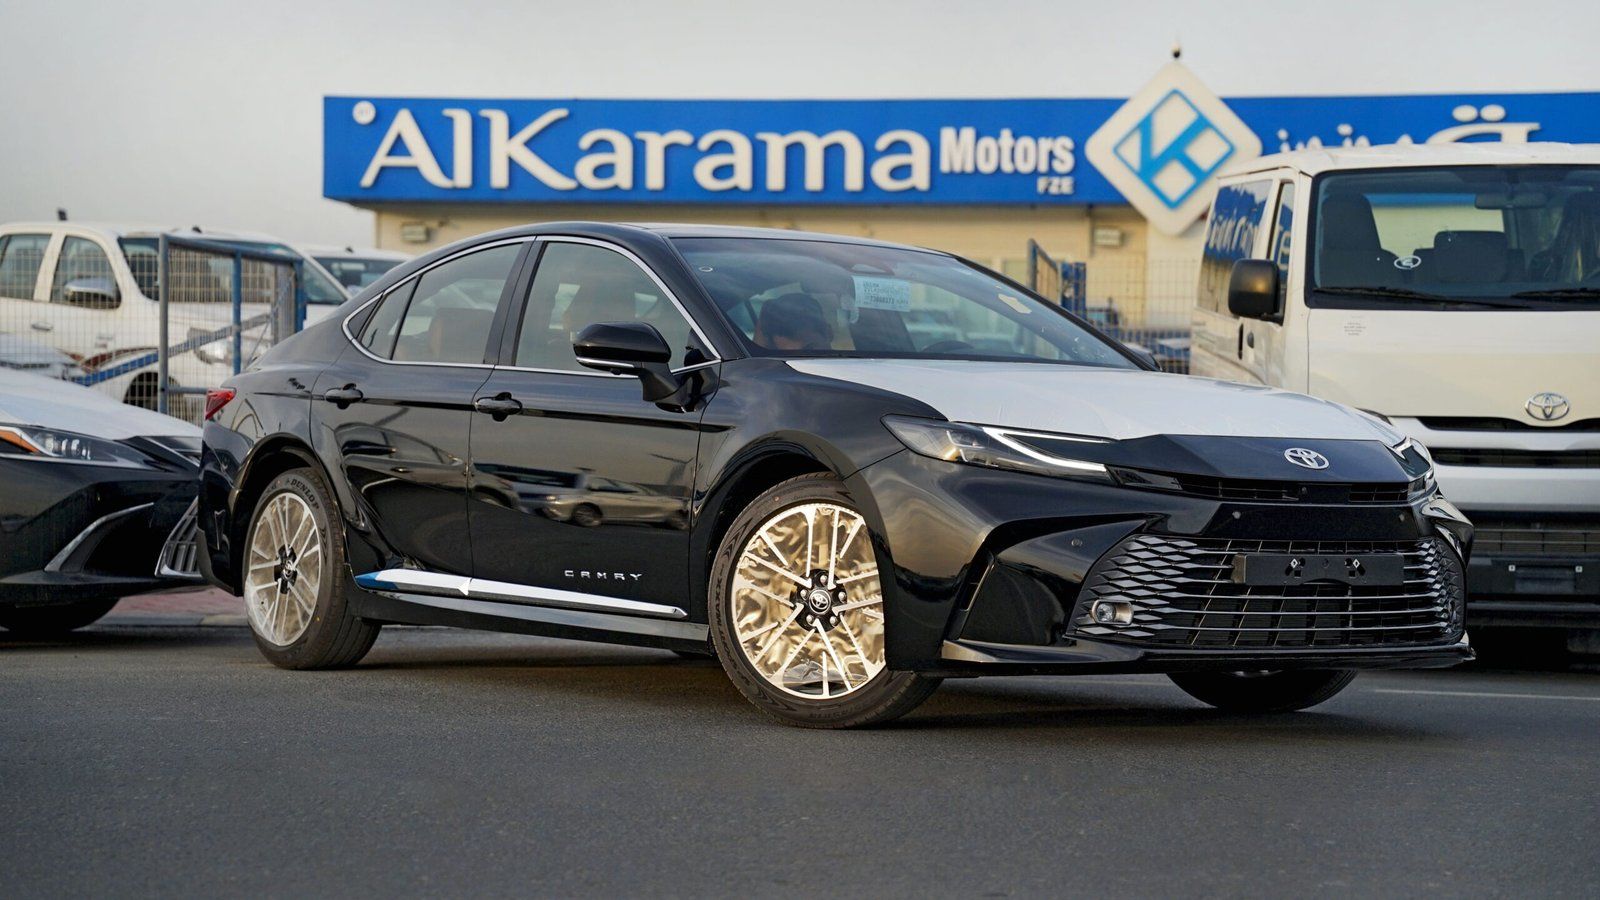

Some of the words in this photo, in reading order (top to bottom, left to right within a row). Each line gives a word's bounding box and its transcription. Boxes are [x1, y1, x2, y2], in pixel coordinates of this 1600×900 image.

[940, 126, 1075, 174] Motors
[1037, 177, 1075, 195] FZE
[291, 478, 320, 509] DUNLOP
[564, 569, 643, 581] CAMRY
